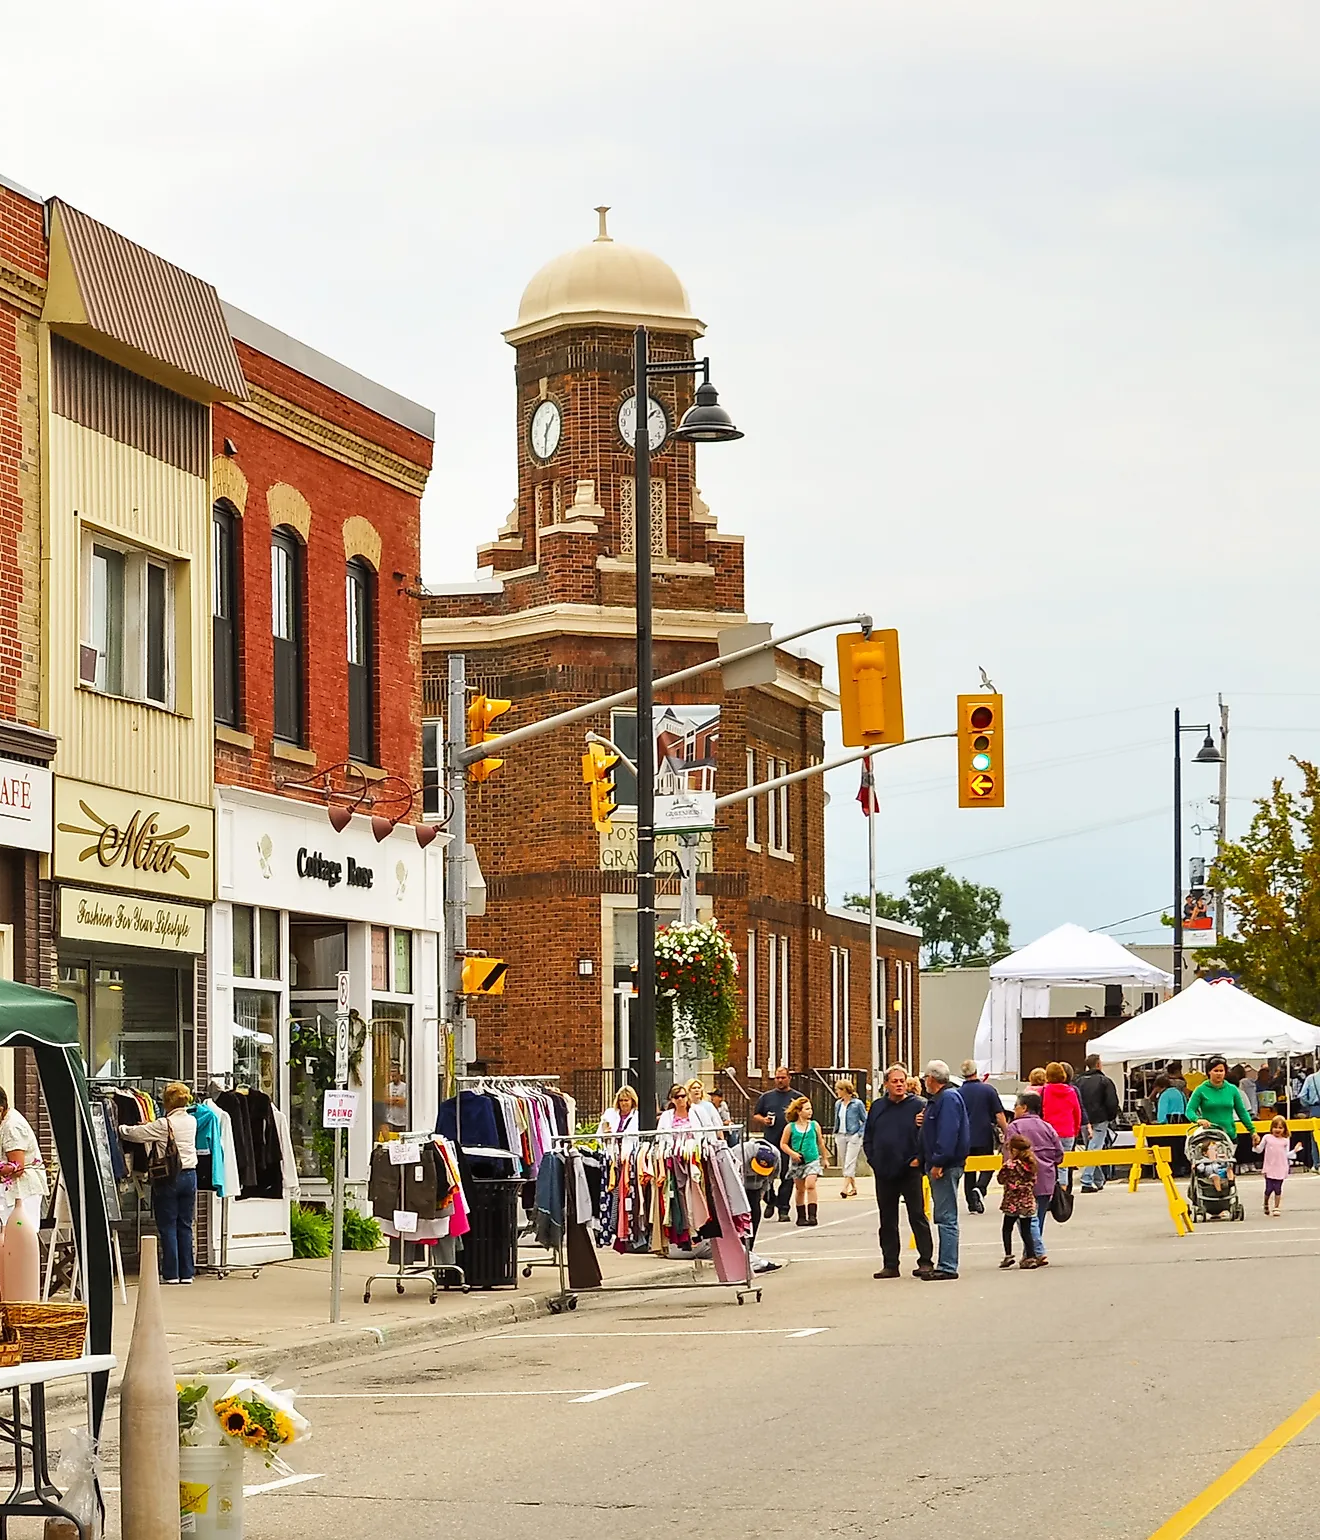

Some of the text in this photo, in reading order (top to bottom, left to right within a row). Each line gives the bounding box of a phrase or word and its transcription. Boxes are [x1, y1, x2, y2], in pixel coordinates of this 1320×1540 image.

[98, 810, 177, 873] Mia
[297, 847, 374, 889] Cottage Rose
[77, 899, 191, 946] Fashion For Your Lifestyle
